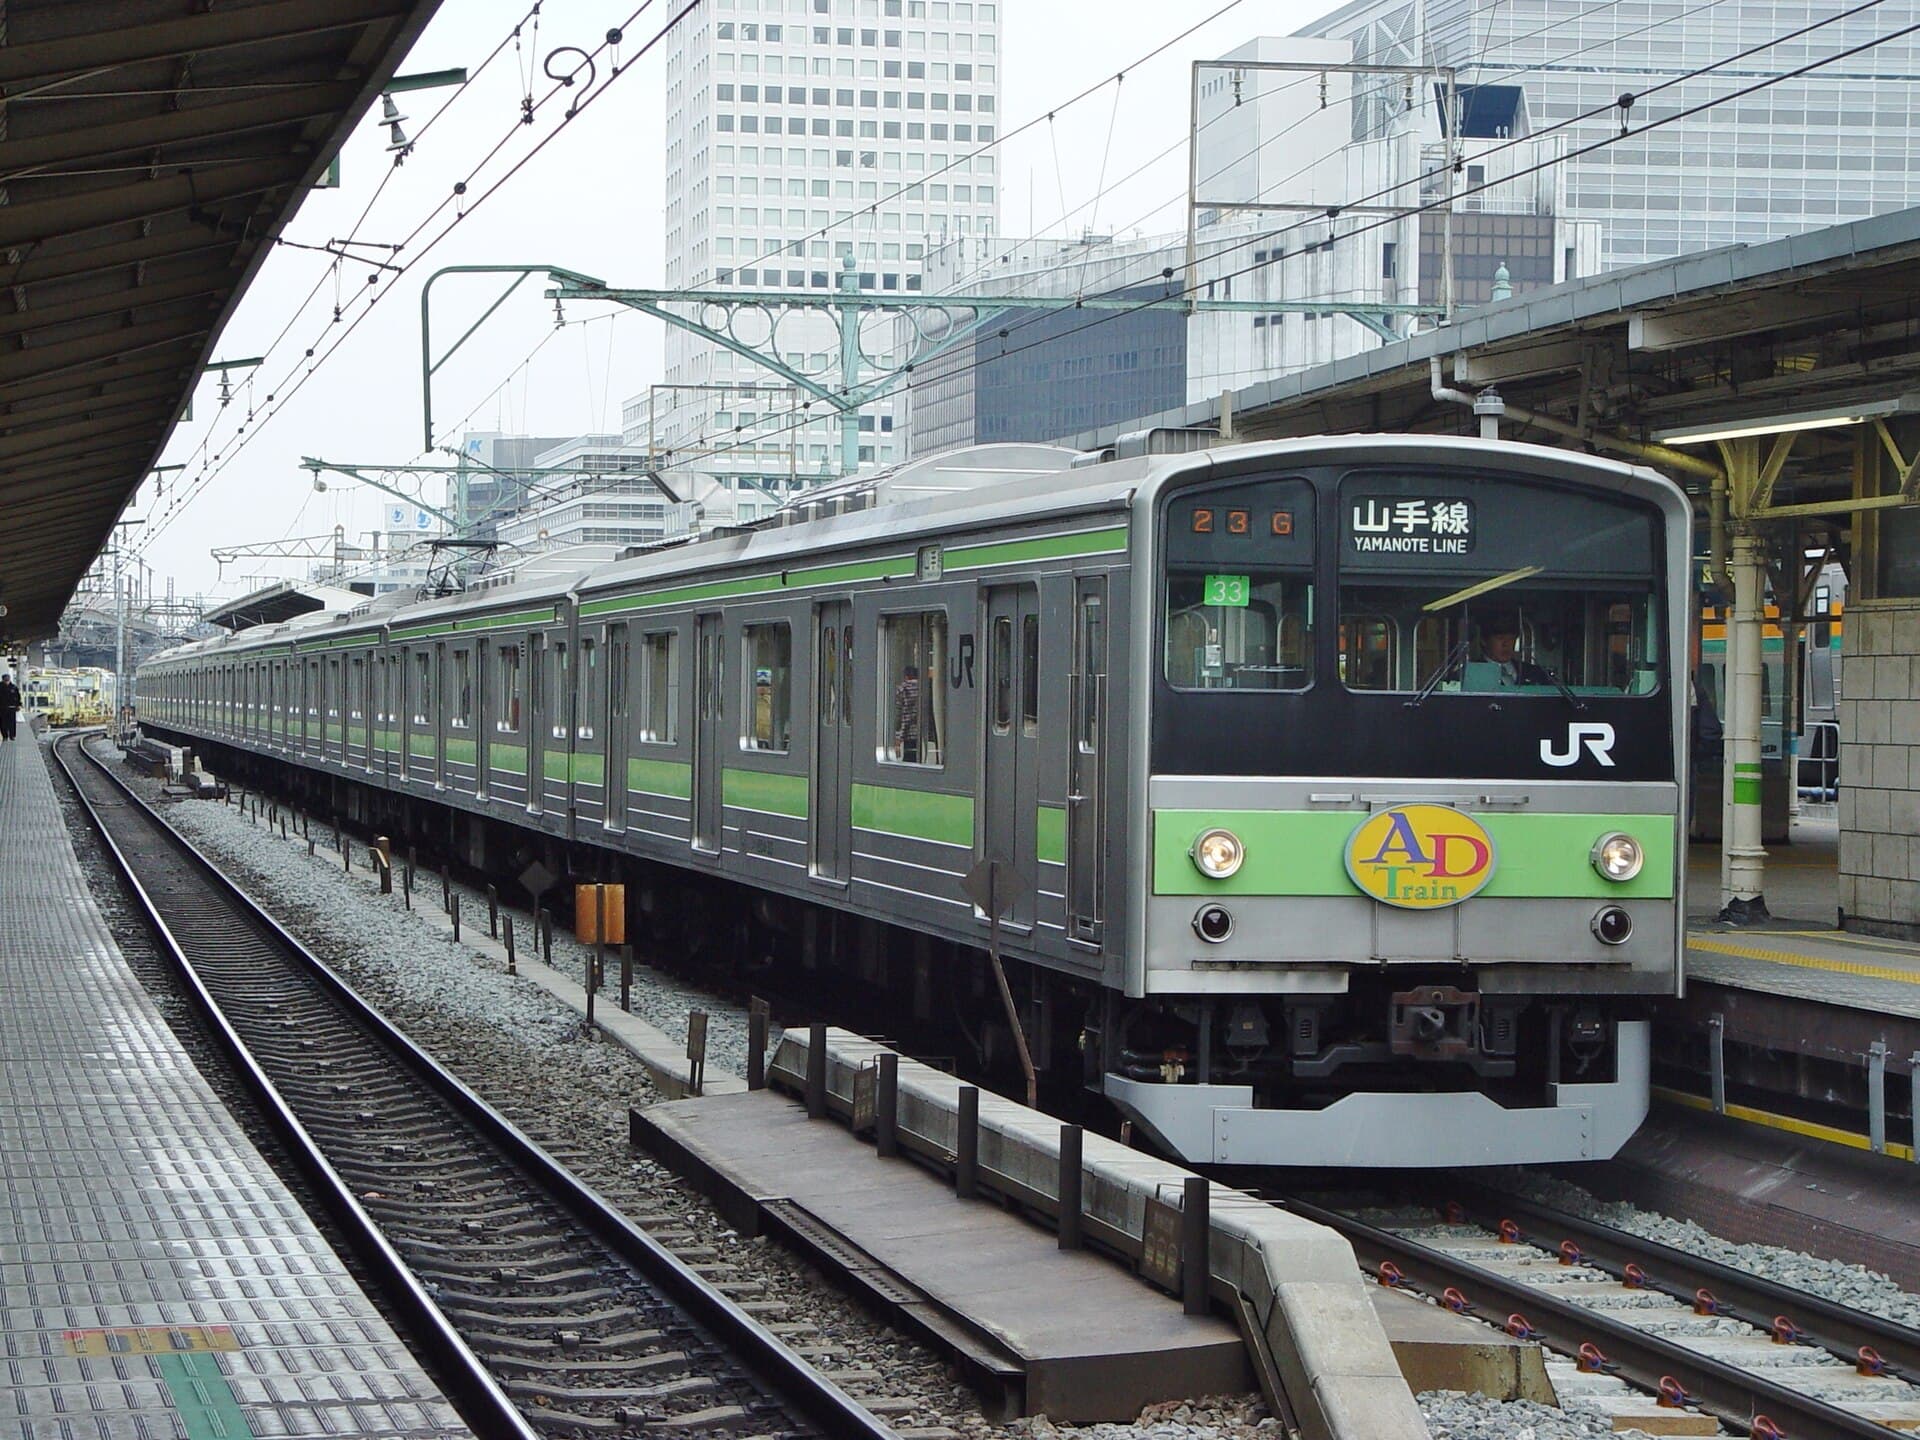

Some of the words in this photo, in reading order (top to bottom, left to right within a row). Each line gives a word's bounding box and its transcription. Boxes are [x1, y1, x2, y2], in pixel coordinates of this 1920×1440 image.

[1353, 500, 1470, 535] 山手線
[1354, 536, 1429, 553] YAMANOTE
[1432, 538, 1467, 554] LINE
[1212, 581, 1242, 602] 33
[951, 634, 974, 689] JR
[1540, 722, 1616, 766] JR
[1358, 812, 1489, 877] AD
[1373, 865, 1458, 899] Train
